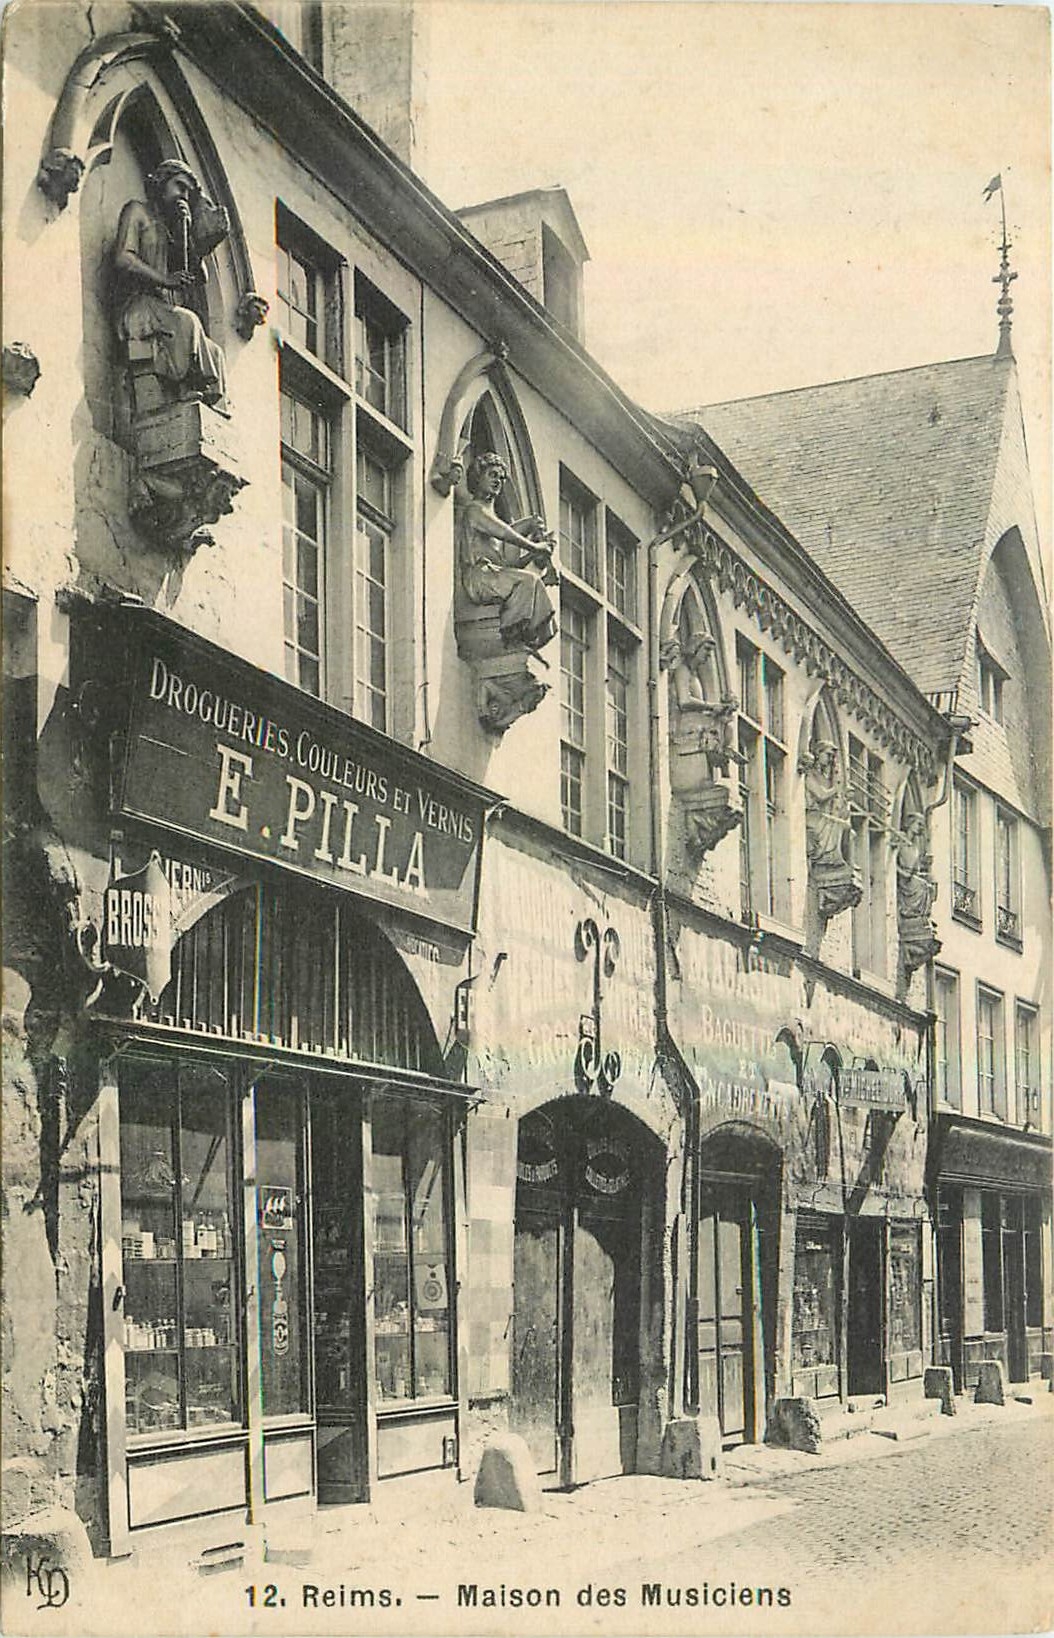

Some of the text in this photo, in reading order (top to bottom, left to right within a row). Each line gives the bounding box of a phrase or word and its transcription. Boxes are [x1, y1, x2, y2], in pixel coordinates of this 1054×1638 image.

[281, 774, 431, 903] PILLA
[297, 731, 388, 803] COULEURS
[417, 787, 474, 843] VERNIS
